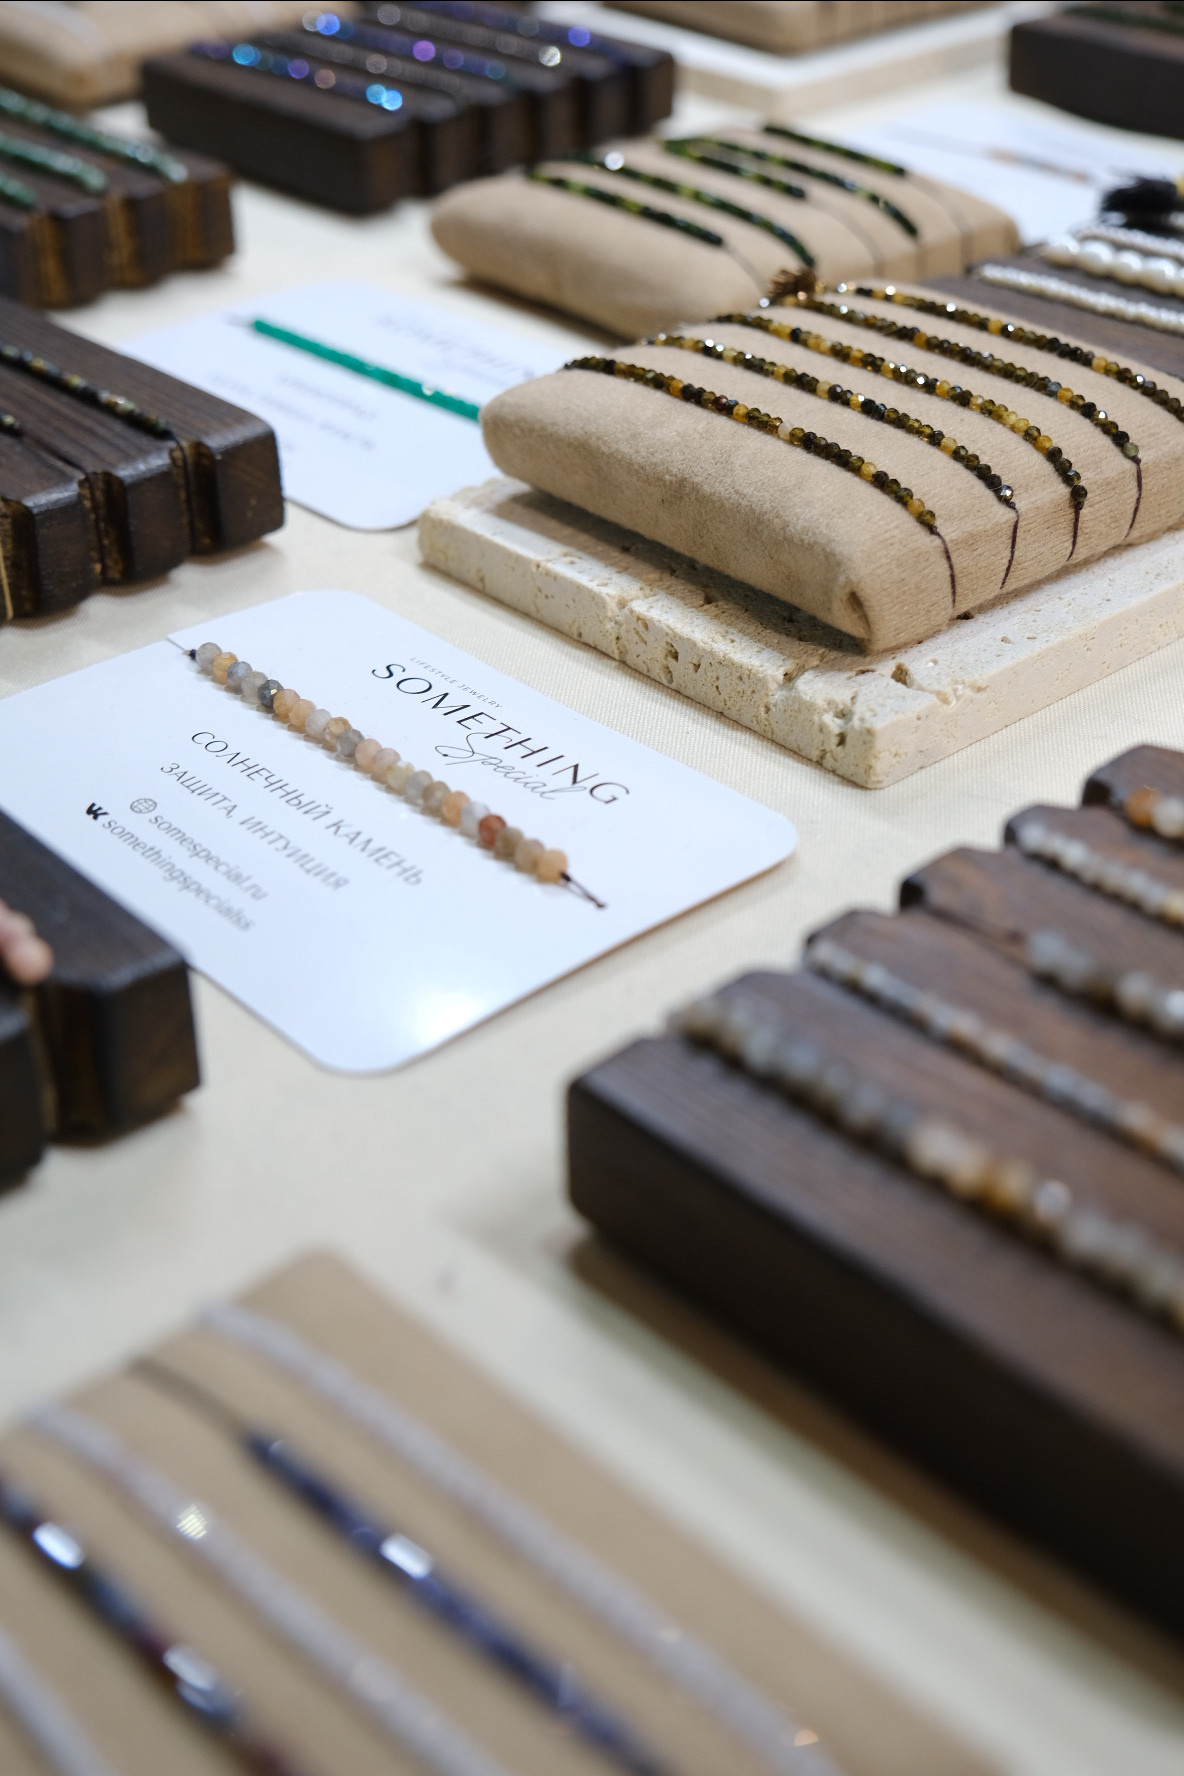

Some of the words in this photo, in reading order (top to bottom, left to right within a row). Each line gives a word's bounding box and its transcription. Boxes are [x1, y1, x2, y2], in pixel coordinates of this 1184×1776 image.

[371, 663, 631, 804] SOMETHING
[410, 657, 458, 684] LIFESTYLE
[457, 683, 503, 709] JEWELRY
[190, 730, 333, 822] СОЛНЕЧНЫЙ
[325, 818, 425, 887] КАМЕНЬ
[434, 731, 587, 800] Special
[148, 814, 269, 902] somespecial.ru
[160, 762, 239, 819] ЗАЩИТА,
[238, 815, 351, 891] ИНТУИЦИЯ
